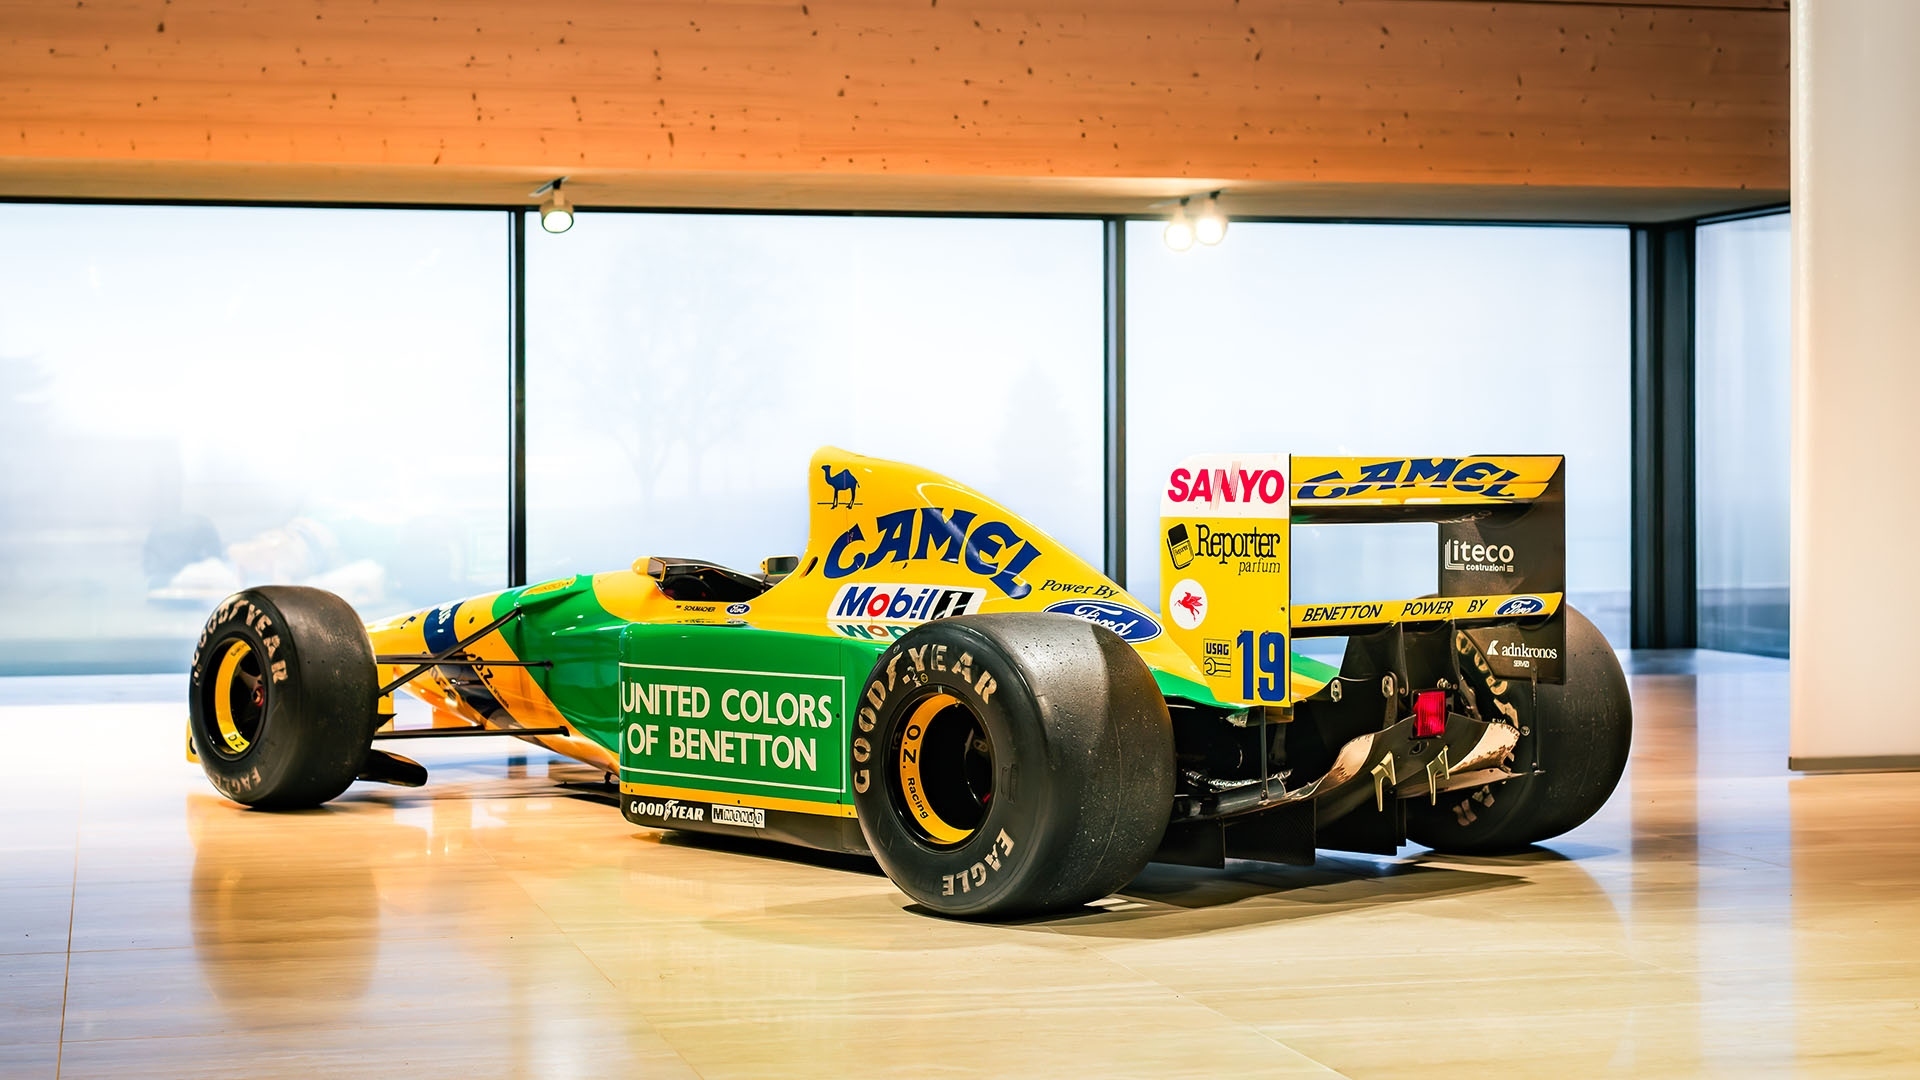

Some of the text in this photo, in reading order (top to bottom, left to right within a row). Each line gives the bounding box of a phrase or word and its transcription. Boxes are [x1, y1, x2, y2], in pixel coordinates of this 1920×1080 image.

[1167, 468, 1285, 504] SANYO
[1297, 458, 1520, 499] CAMEL
[823, 507, 1041, 600] CAMEL
[1194, 524, 1281, 565] Reporter
[1238, 557, 1281, 576] parfum
[836, 586, 940, 620] Mobil
[1039, 579, 1120, 599] Power By
[1073, 604, 1139, 637] Ford
[1301, 599, 1537, 622] BENETTON POWER BY Ford
[1206, 642, 1230, 656] USAG
[1236, 630, 1286, 702] 19
[1501, 642, 1558, 660] adnkronos
[621, 681, 832, 729] UNITED COLORS
[627, 722, 817, 772] OF BENETTON
[630, 800, 704, 821] GOODYEAR
[907, 777, 929, 819] Racing
[943, 828, 1015, 896] EAGLE
